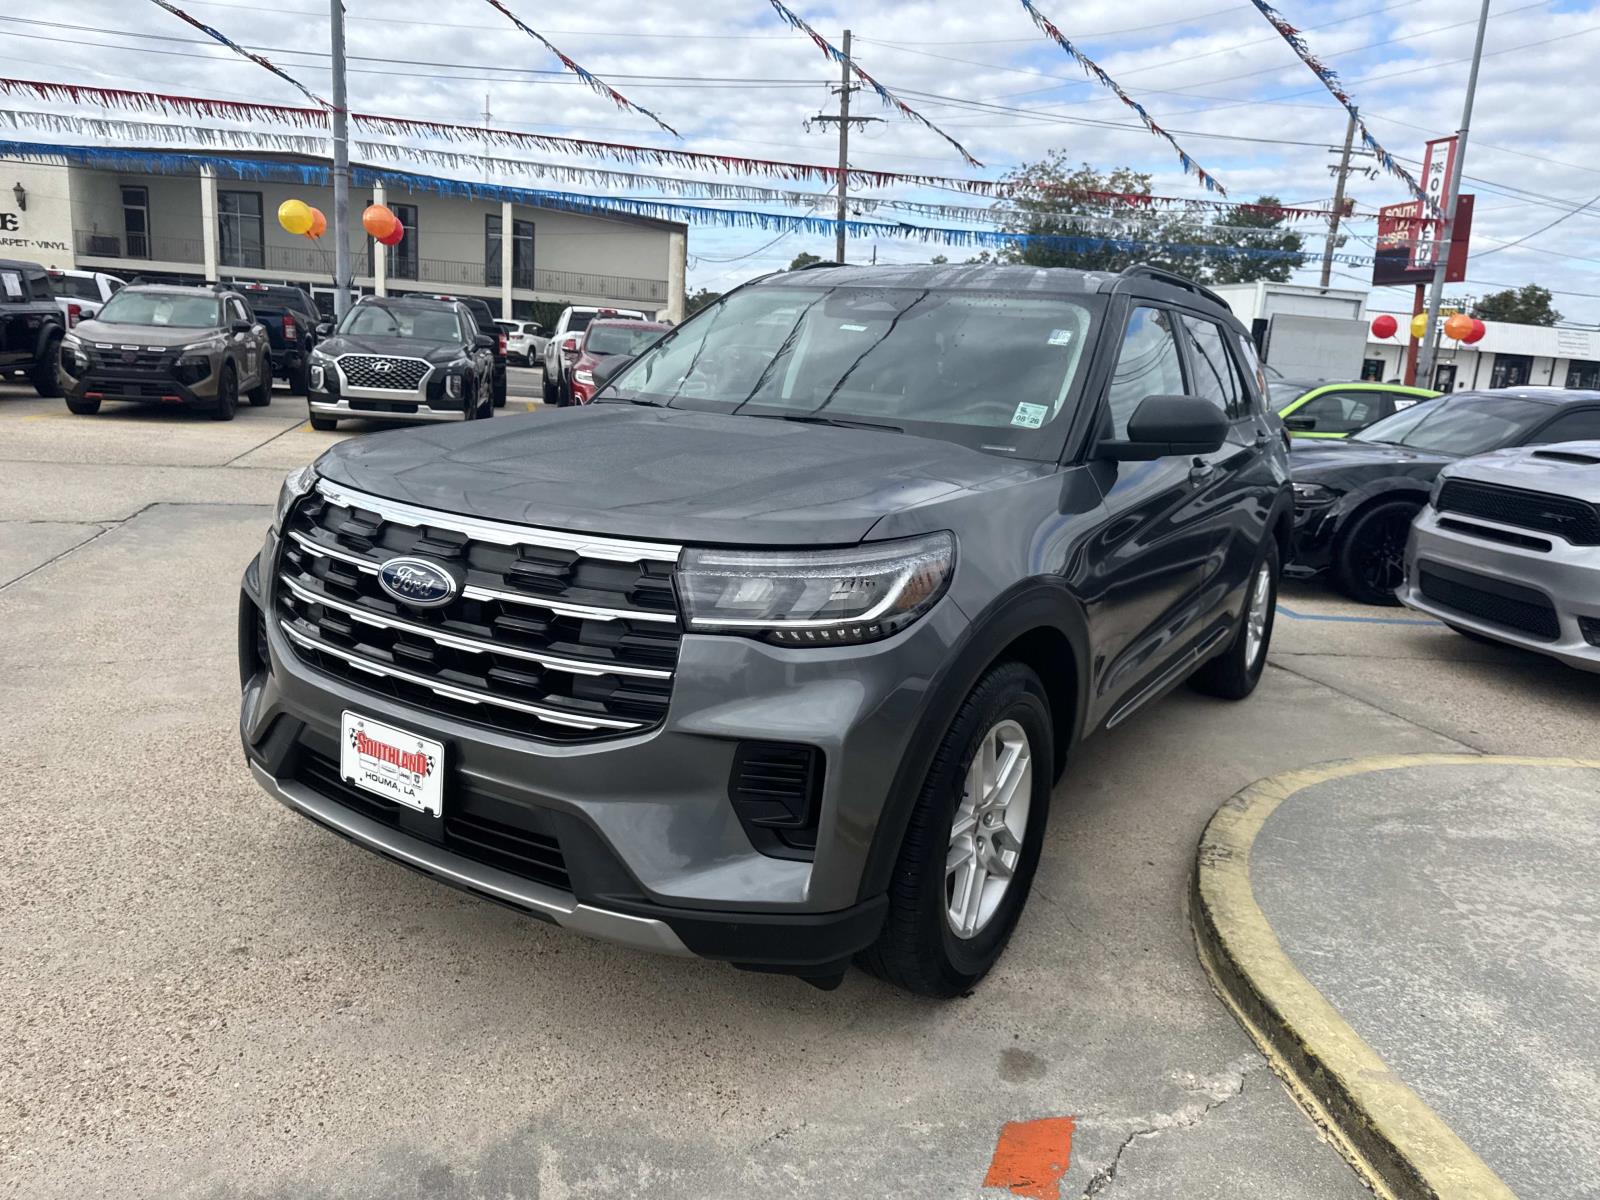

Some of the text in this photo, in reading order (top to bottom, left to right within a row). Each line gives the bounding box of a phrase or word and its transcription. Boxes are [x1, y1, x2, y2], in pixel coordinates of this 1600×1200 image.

[36, 241, 70, 250] VINYL
[392, 566, 435, 596] Ford
[356, 731, 427, 777] SOUTHLAND
[365, 772, 416, 797] HOUMA, LA
